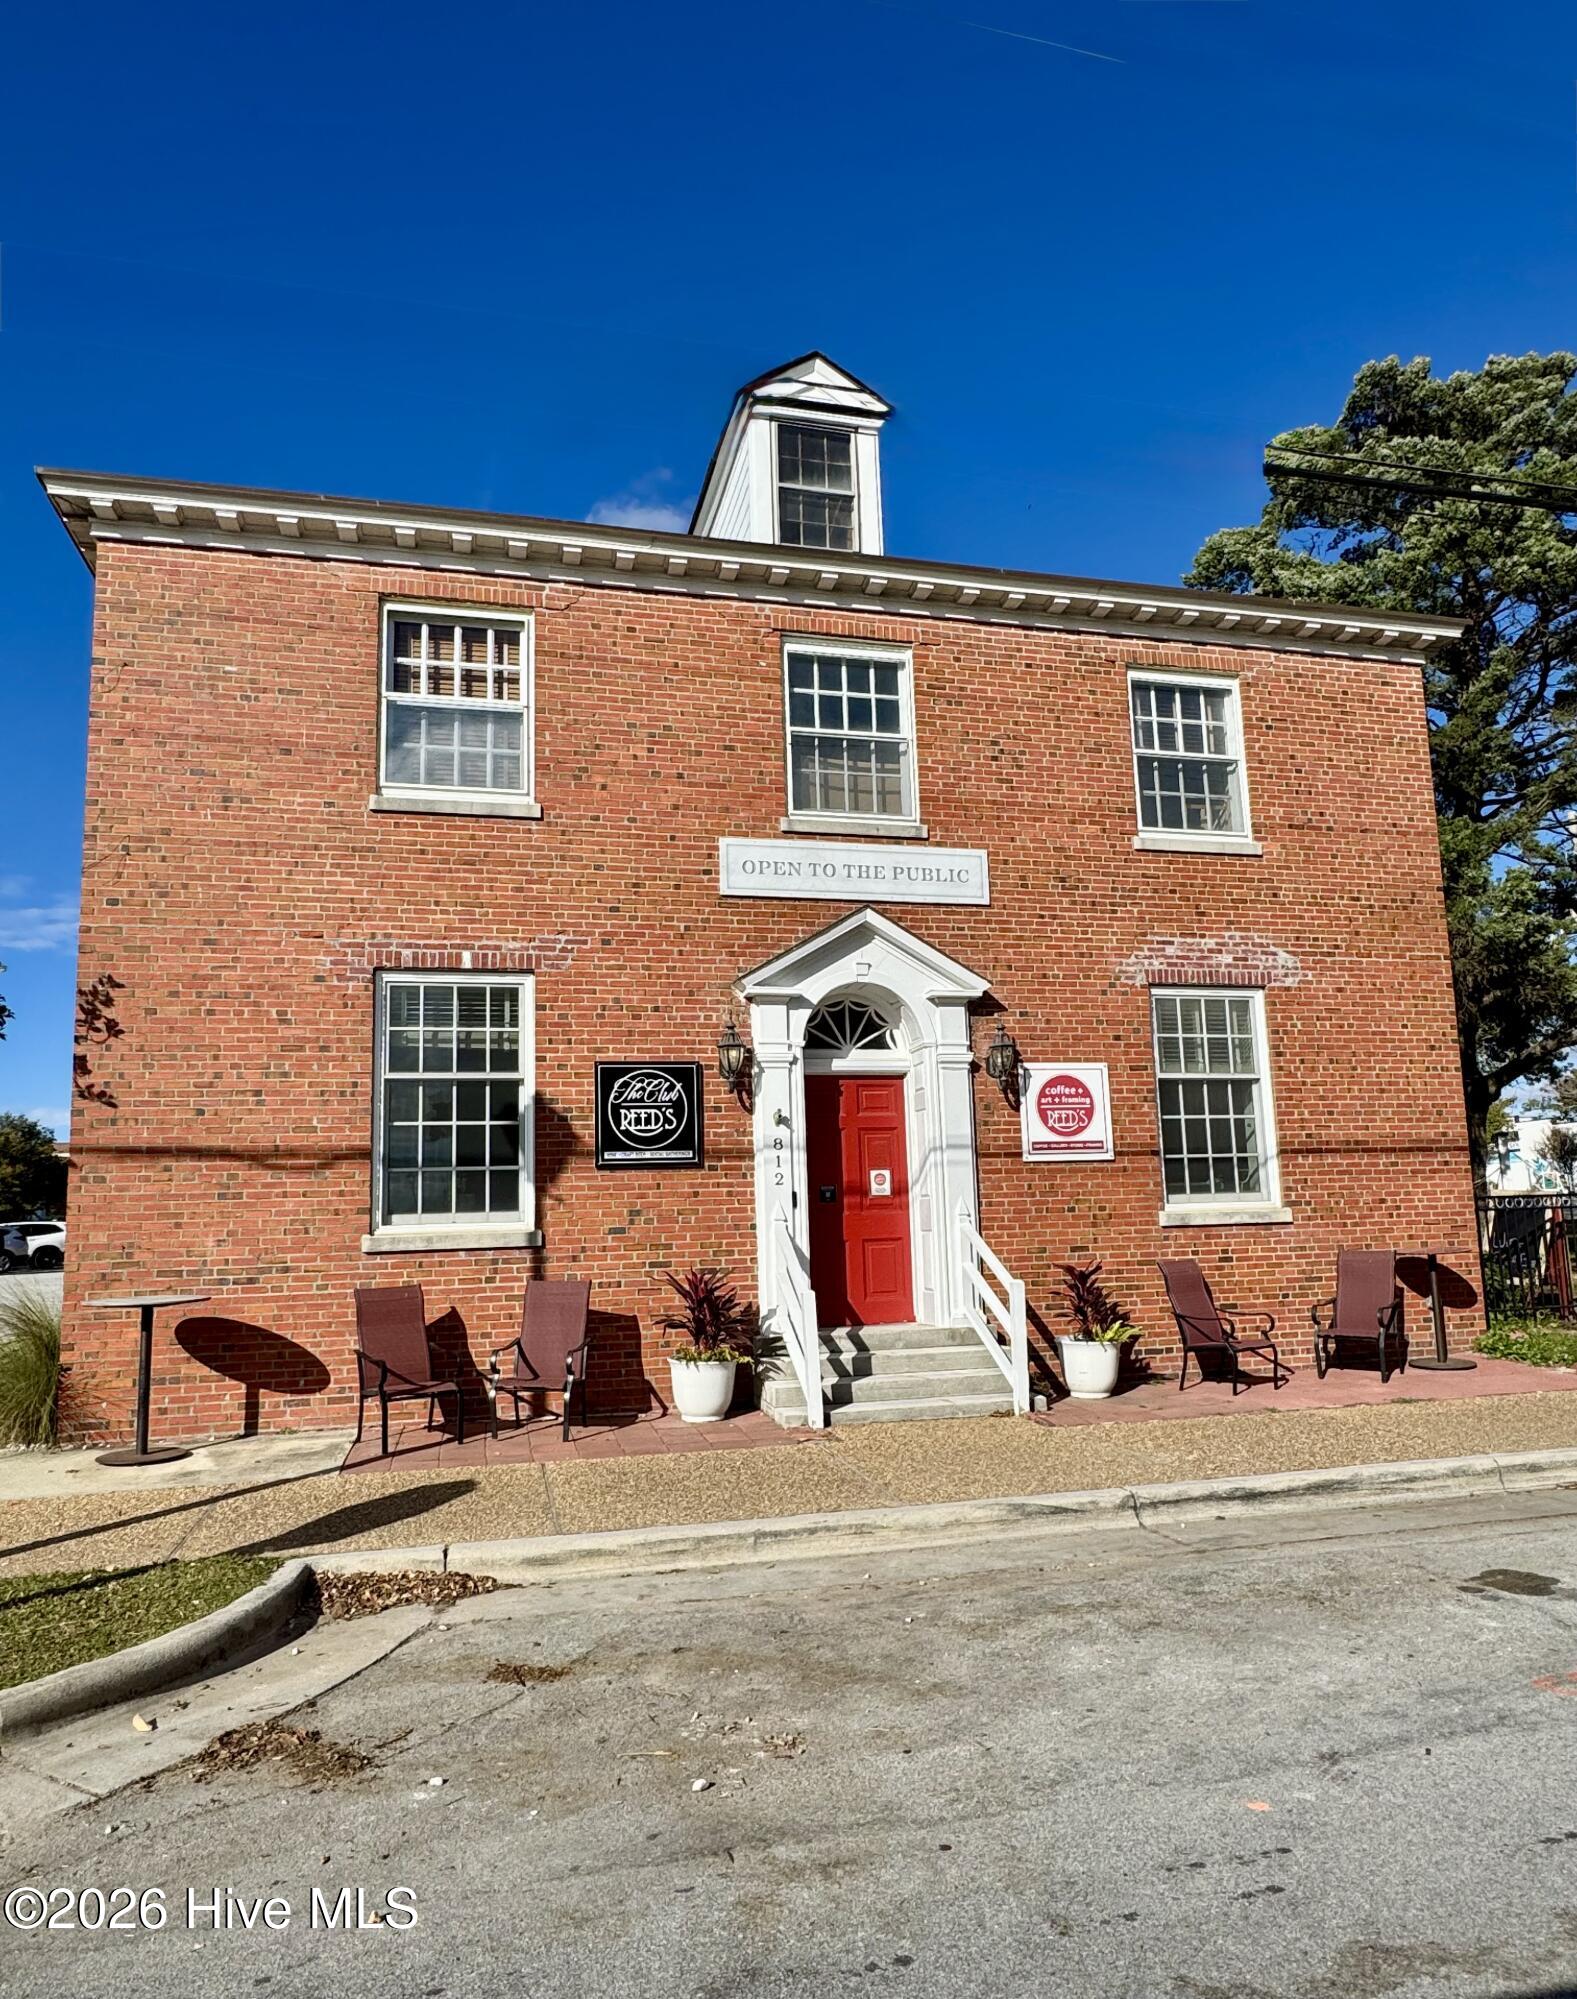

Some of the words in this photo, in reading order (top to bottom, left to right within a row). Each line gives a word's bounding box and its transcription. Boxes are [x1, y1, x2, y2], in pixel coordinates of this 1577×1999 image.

[741, 859, 802, 876] OPEN
[808, 862, 837, 878] TO
[842, 864, 886, 880] THE
[892, 866, 970, 883] PUBLIC
[613, 1077, 645, 1103] The
[644, 1078, 683, 1103] Club
[1045, 1085, 1076, 1095] coffee
[1061, 1096, 1090, 1104] framing
[619, 1107, 677, 1136] REED'S
[1047, 1109, 1088, 1131] REED'S
